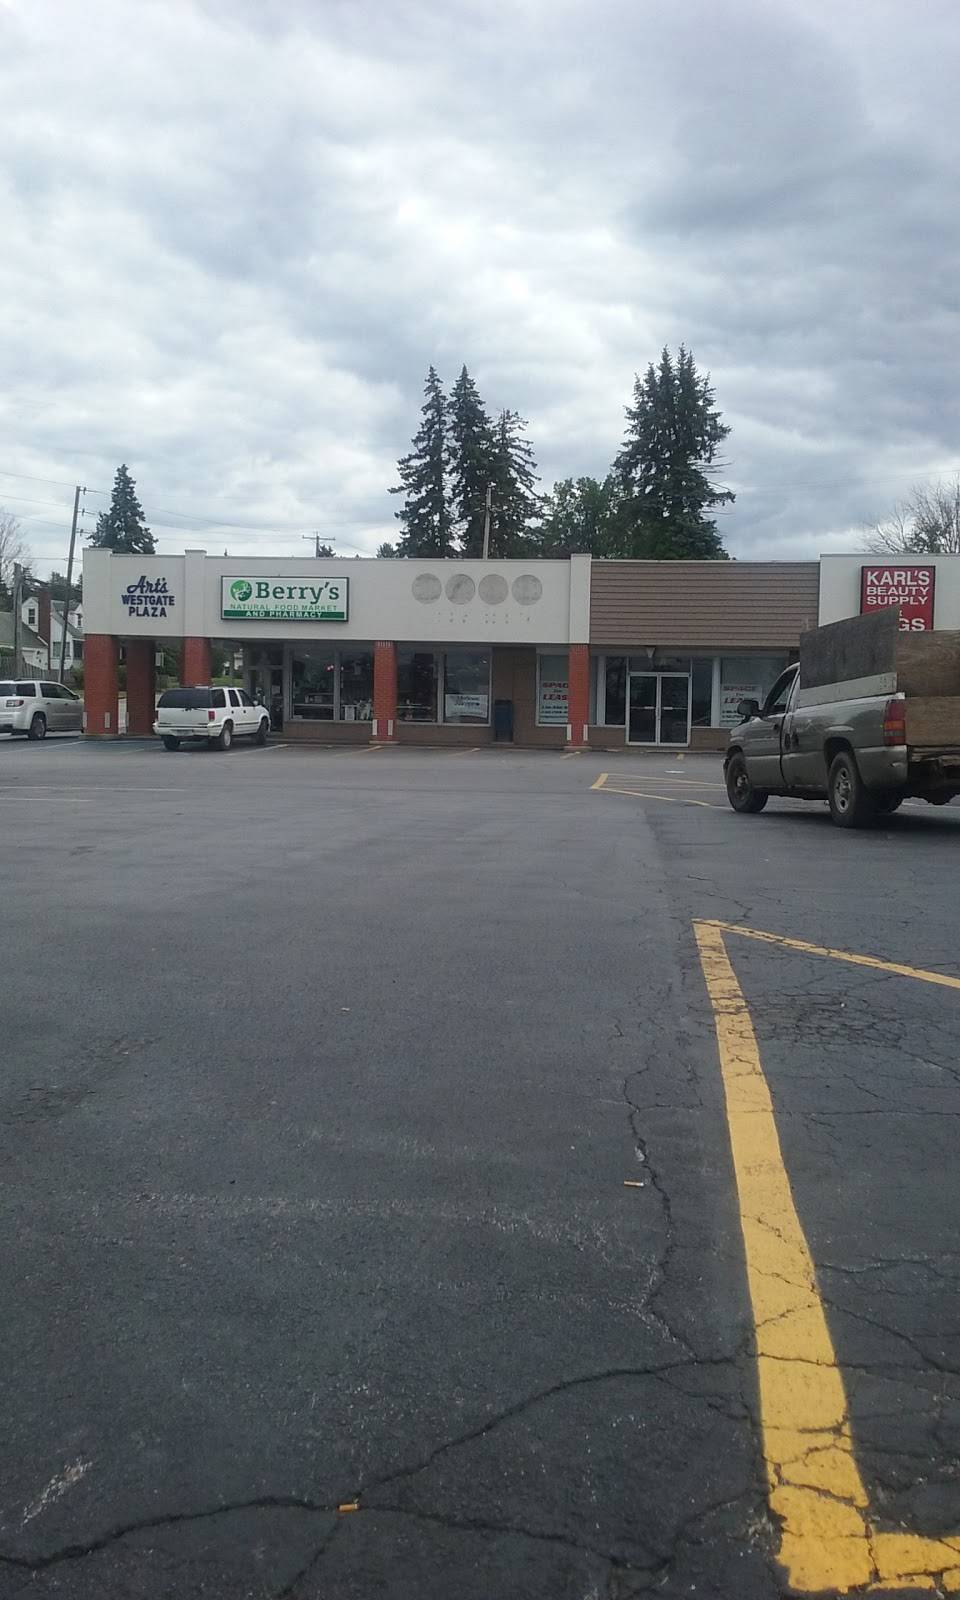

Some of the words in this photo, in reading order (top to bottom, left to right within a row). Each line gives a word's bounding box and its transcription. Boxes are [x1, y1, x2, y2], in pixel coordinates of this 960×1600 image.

[867, 570, 930, 586] KARL'S
[127, 575, 169, 594] Art's
[255, 581, 340, 605] Berry's
[866, 586, 930, 596] BEAUTY
[121, 594, 176, 606] WESTGATE
[866, 596, 928, 606] SUPPLY
[128, 606, 168, 618] PLAZA
[230, 603, 270, 611] NATURAL
[301, 604, 338, 612] MARKET
[898, 617, 926, 632] GS
